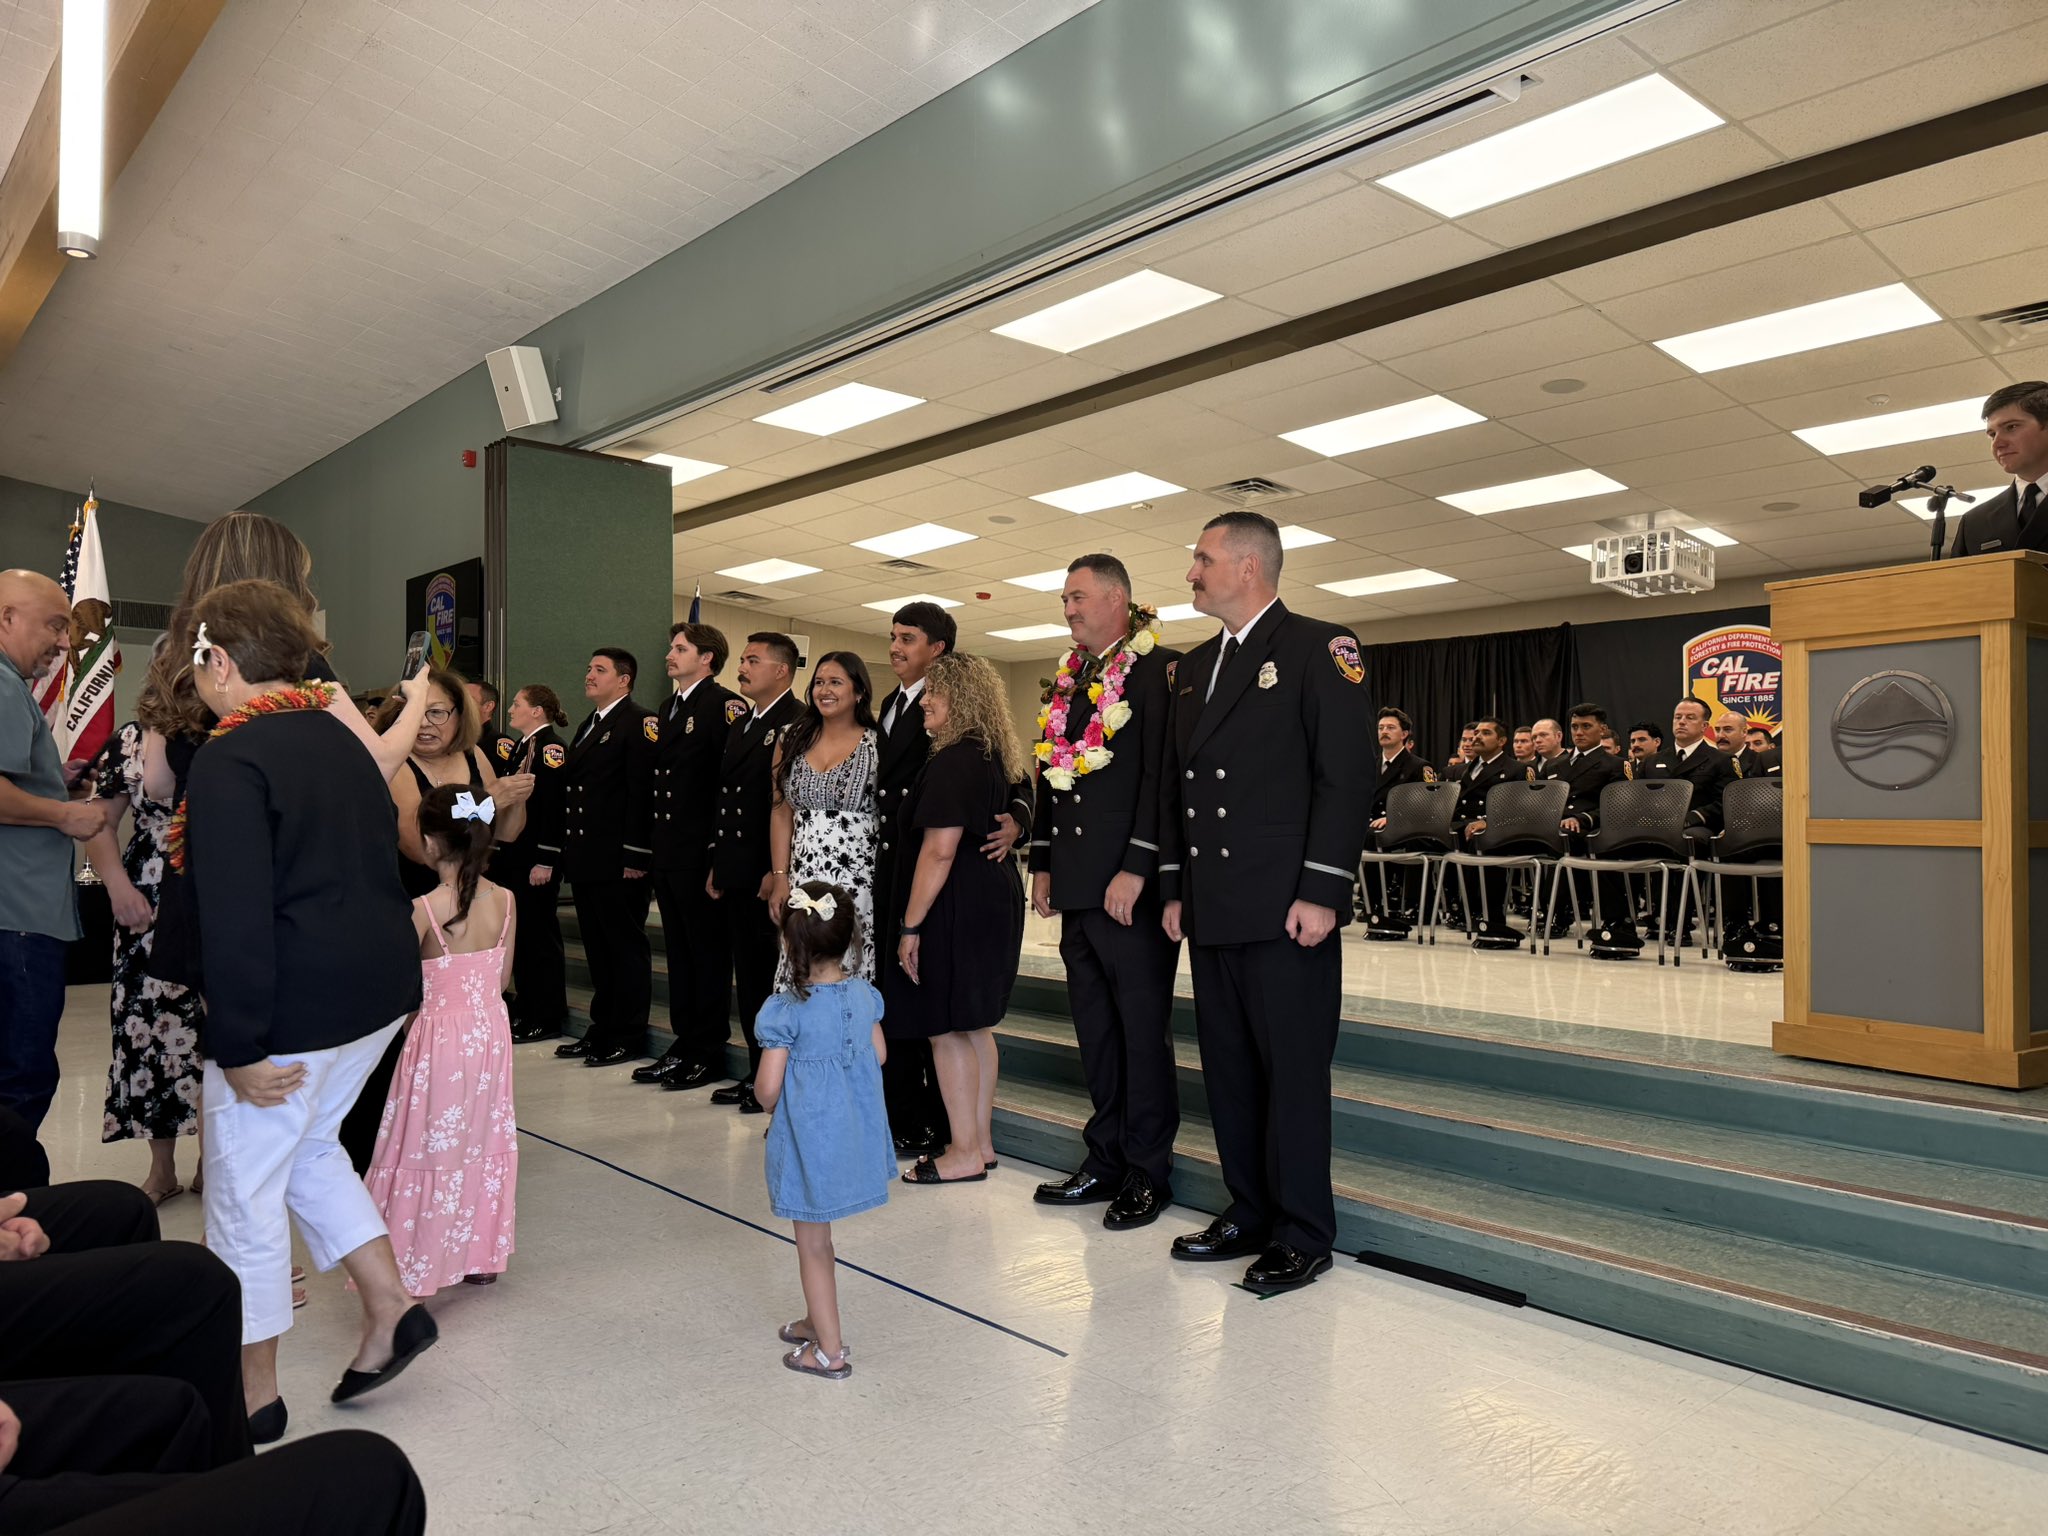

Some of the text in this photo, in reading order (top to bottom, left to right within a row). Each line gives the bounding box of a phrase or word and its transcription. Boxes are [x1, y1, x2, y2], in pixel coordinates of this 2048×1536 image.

[431, 595, 445, 612] CAL
[437, 608, 454, 626] FIRE
[1335, 647, 1350, 655] CAL
[1690, 645, 1720, 662] FORESTRY
[1742, 641, 1782, 656] PROTECTION
[1691, 635, 1727, 654] CALIFORNIA
[1728, 633, 1770, 642] DEPARTMENT
[1701, 655, 1749, 676] CAL
[1723, 671, 1781, 692] FIRE
[66, 659, 115, 732] CALIFORNIA
[1722, 694, 1775, 704] SINCE 1885
